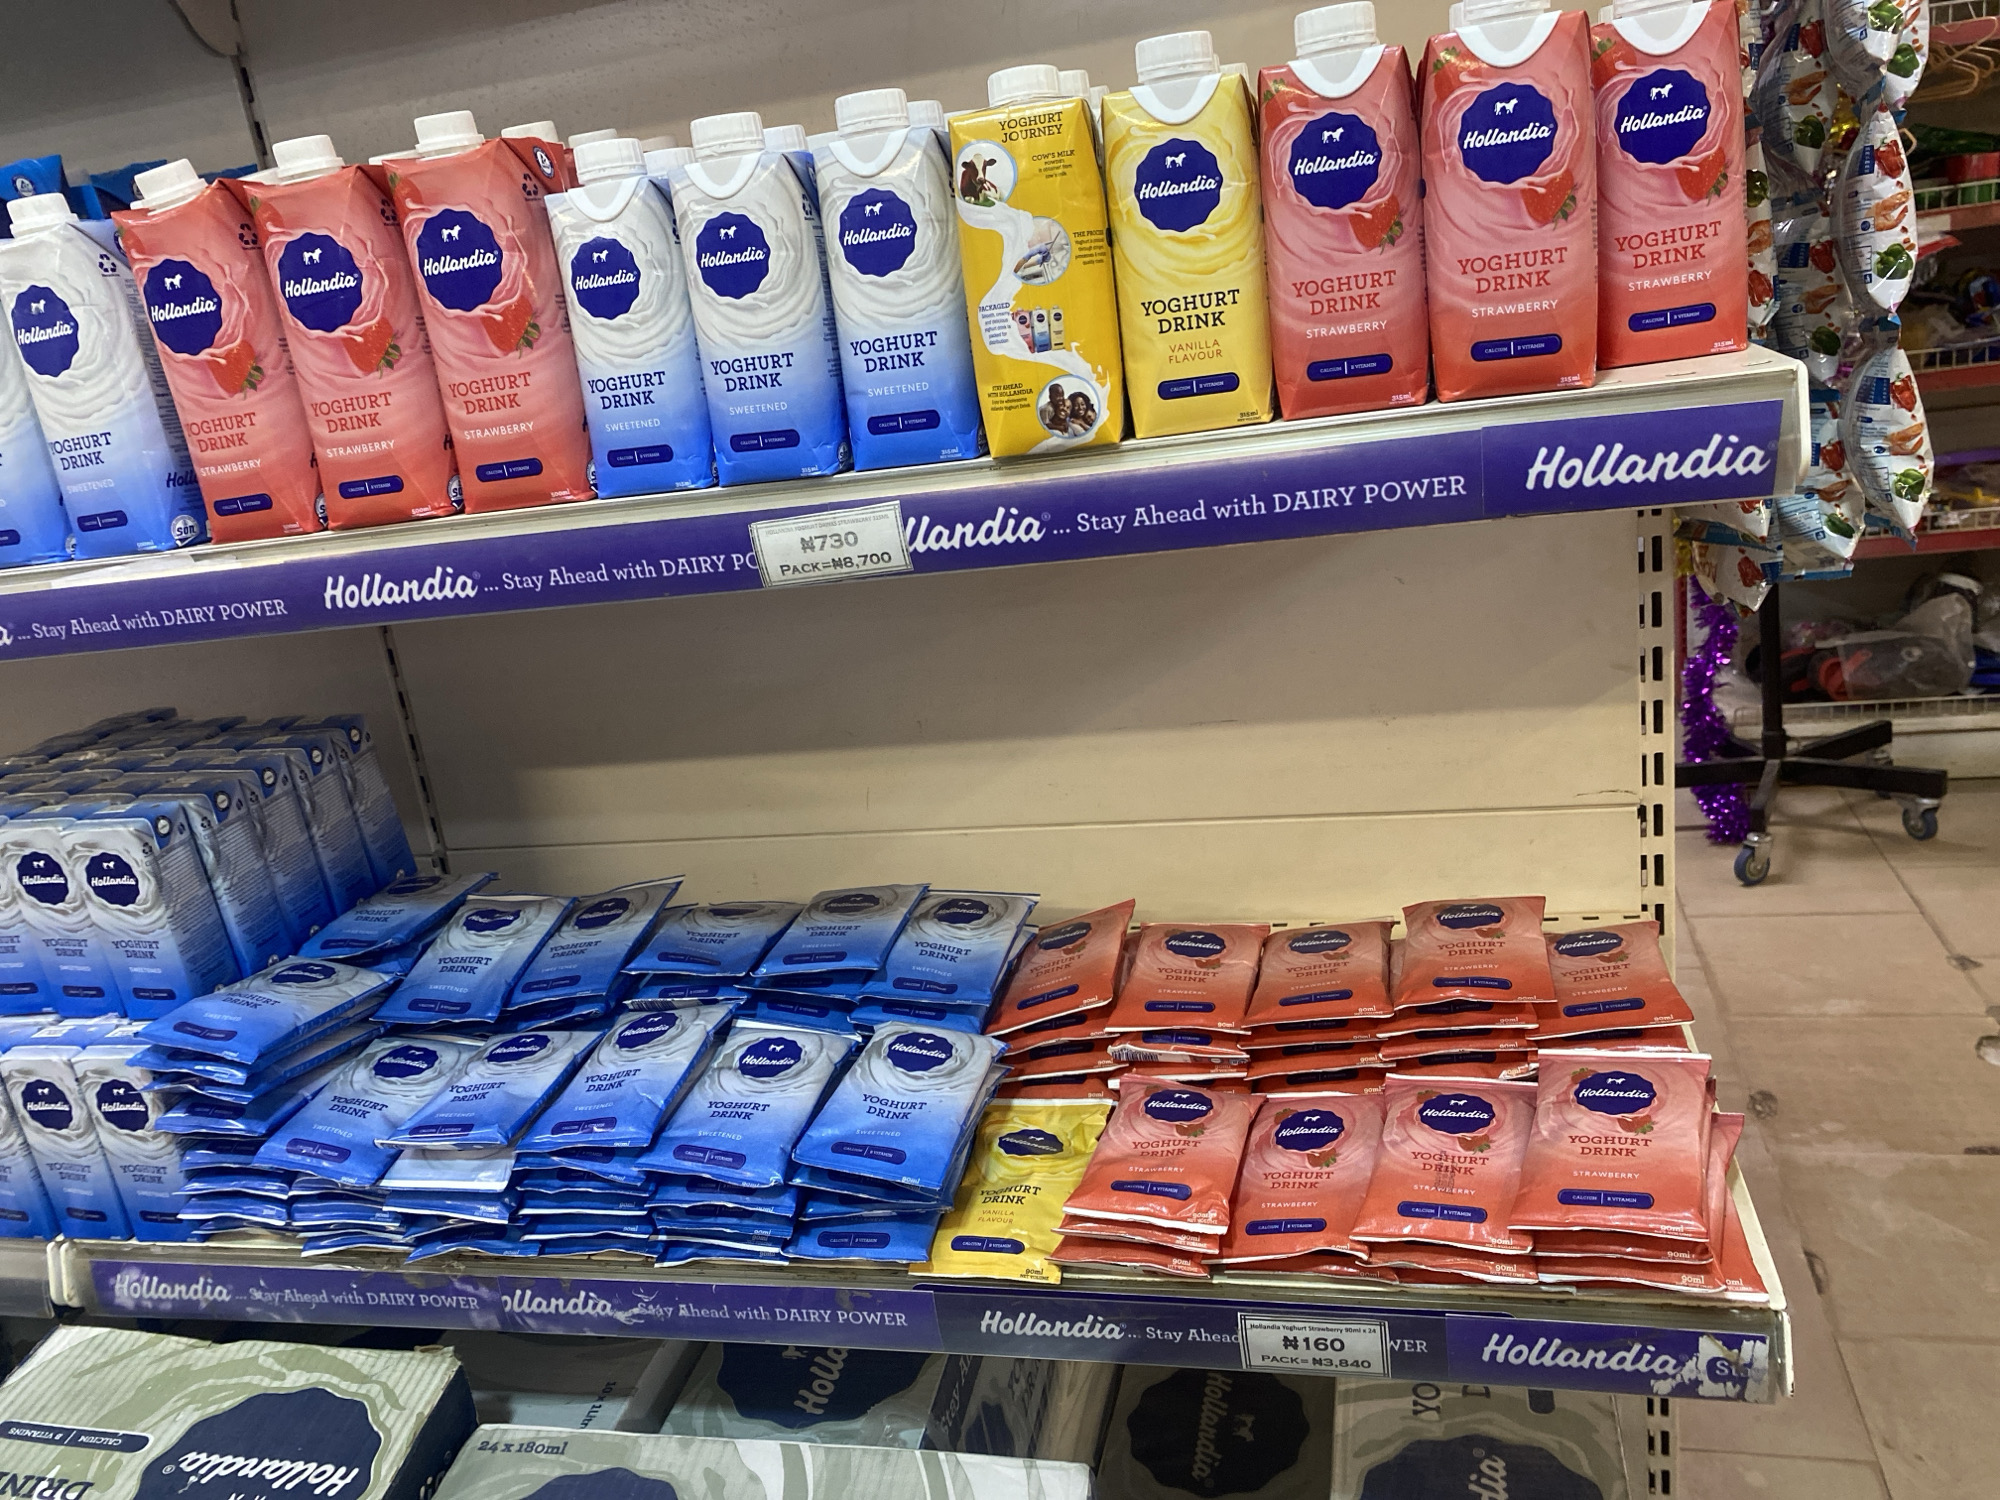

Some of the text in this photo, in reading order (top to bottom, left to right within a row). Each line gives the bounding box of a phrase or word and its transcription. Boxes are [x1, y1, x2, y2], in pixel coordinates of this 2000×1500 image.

[999, 111, 1063, 131] YOGHURT
[1620, 104, 1706, 134] Hollandia
[1001, 123, 1063, 144] JOURNEY
[1463, 122, 1552, 149] Hollandia
[1057, 149, 1076, 158] MILK
[1294, 150, 1376, 176] Hollandia
[1140, 175, 1218, 200] Hollandia
[843, 221, 912, 247] Hollandia
[1613, 220, 1722, 252] YOGHURT
[424, 249, 498, 277] Hollandia
[700, 246, 766, 269] Hollandia
[1457, 246, 1568, 276] YOGHURT
[1632, 243, 1706, 270] DRINK
[285, 272, 357, 299] Hollandia
[575, 270, 637, 291] Hollandia
[1291, 269, 1397, 298] YOGHURT
[1475, 269, 1551, 294] DRINK
[1628, 270, 1713, 292] STRAWBERRY
[151, 297, 217, 323] Hollandia
[1140, 288, 1240, 317] YOGHURT
[1309, 292, 1381, 316] DRINK
[1471, 299, 1559, 318] STRAWBERRY
[1158, 310, 1226, 335] DRINK
[1306, 319, 1388, 339] STRAWBERRY
[17, 321, 74, 346] Hollandia
[850, 330, 938, 357] YOGHURT
[1169, 338, 1221, 353] VANILLA
[710, 352, 794, 376] YOGHURT
[864, 352, 926, 374] DRINK
[1168, 349, 1223, 365] FLAVOUR
[448, 371, 532, 398] YOGHURT
[587, 371, 666, 394] YOGHURT
[725, 372, 783, 393] DRINK
[867, 381, 930, 398] SWEETENED
[310, 391, 392, 417] YOGHURT
[464, 392, 522, 415] DRINK
[600, 390, 656, 410] DRINK
[729, 401, 788, 416] SWEETENED
[326, 412, 382, 433] DRINK
[463, 421, 534, 440] STRAWBERRY
[605, 418, 662, 433] SWEETENED
[199, 433, 250, 454] DRINK
[326, 439, 395, 458] STRAWBERRY
[60, 450, 105, 471] DRINK
[200, 458, 262, 477] STRAWBERRY
[1525, 432, 1772, 491] Hollandia
[905, 474, 1468, 554] llandia Stay Ahead with DAIRY POWER
[800, 530, 859, 554] ₦730
[323, 565, 479, 610] Hollandia
[502, 572, 544, 592] Stay
[549, 563, 609, 586] Ahead
[612, 559, 657, 581] with
[661, 554, 726, 577] DAIRY
[32, 622, 67, 641] Stay
[70, 613, 122, 636] Ahead
[122, 610, 160, 631] with
[160, 605, 216, 627] DAIRY
[221, 598, 289, 622] POWER
[91, 875, 137, 887] Hollandia
[914, 940, 972, 957] YOGHURT
[1437, 940, 1506, 951] YOGHURT
[1447, 948, 1496, 957] DRINK
[1558, 937, 1619, 951] Hollandia
[437, 956, 492, 968] YOGHURT
[918, 949, 959, 964] DRINK
[438, 963, 480, 975] DRINK
[1560, 962, 1631, 979] YOGHURT
[1572, 970, 1623, 983] DRINK
[890, 1041, 948, 1060] Hollandia
[741, 1054, 798, 1068] Hollandia
[584, 1068, 641, 1084] YOGHURT
[585, 1079, 625, 1093] DRINK
[1579, 1085, 1652, 1100] Hollandia
[101, 1101, 147, 1113] Hollandia
[706, 1100, 770, 1115] YOGHURT
[862, 1093, 927, 1112] YOGHURT
[1148, 1098, 1211, 1111] Hollandia
[708, 1109, 754, 1122] DRINK
[865, 1105, 912, 1121] DRINK
[1422, 1106, 1491, 1120] Hollandia
[1279, 1123, 1340, 1138] Hollandia
[1132, 1138, 1202, 1151] YOGHURT
[1568, 1134, 1653, 1148] YOGHURT
[1138, 1147, 1187, 1158] DRINK
[1411, 1150, 1490, 1166] YOGHURT
[1579, 1146, 1638, 1158] DRINK
[1128, 1165, 1185, 1174] STRAWBERRY
[1263, 1170, 1335, 1183] YOGHURT
[1422, 1162, 1475, 1177] DRINK
[1572, 1169, 1641, 1180] STRAWBERRY
[979, 1184, 1042, 1198] YOGHURT
[1270, 1179, 1319, 1190] DRINK
[981, 1193, 1025, 1205] DRINK
[1260, 1200, 1318, 1209] STRAWBERRY
[977, 1216, 1014, 1225] FLAVOUR
[981, 1208, 1015, 1217] VANILLA
[1171, 1257, 1192, 1267] 90ml
[1494, 1263, 1518, 1273] 90ml
[1025, 1267, 1044, 1277] 90ml
[113, 1274, 480, 1311] Hollandia Stay Ahead with DAIRY POWER
[501, 1288, 614, 1316] ollandia
[678, 1302, 730, 1320] Ahead
[733, 1305, 772, 1322] with
[775, 1307, 832, 1324] DAIRY
[837, 1310, 908, 1328] POWER
[980, 1309, 1126, 1341] Hollandia
[1145, 1326, 1183, 1344] Stay
[1250, 1323, 1281, 1331] Hollandia
[1282, 1324, 1307, 1332] Yoghurt
[1308, 1325, 1343, 1334] Strawberry
[1386, 1338, 1429, 1355] WER
[1481, 1331, 1682, 1376] Hollandia
[793, 1346, 851, 1415] Holla
[8, 1427, 54, 1440] VITAMINS
[78, 1434, 122, 1446] CALCIUM
[477, 1440, 569, 1456] 24 x 180ml
[178, 1450, 359, 1496] Hollandia
[0, 1471, 95, 1500] DRIN
